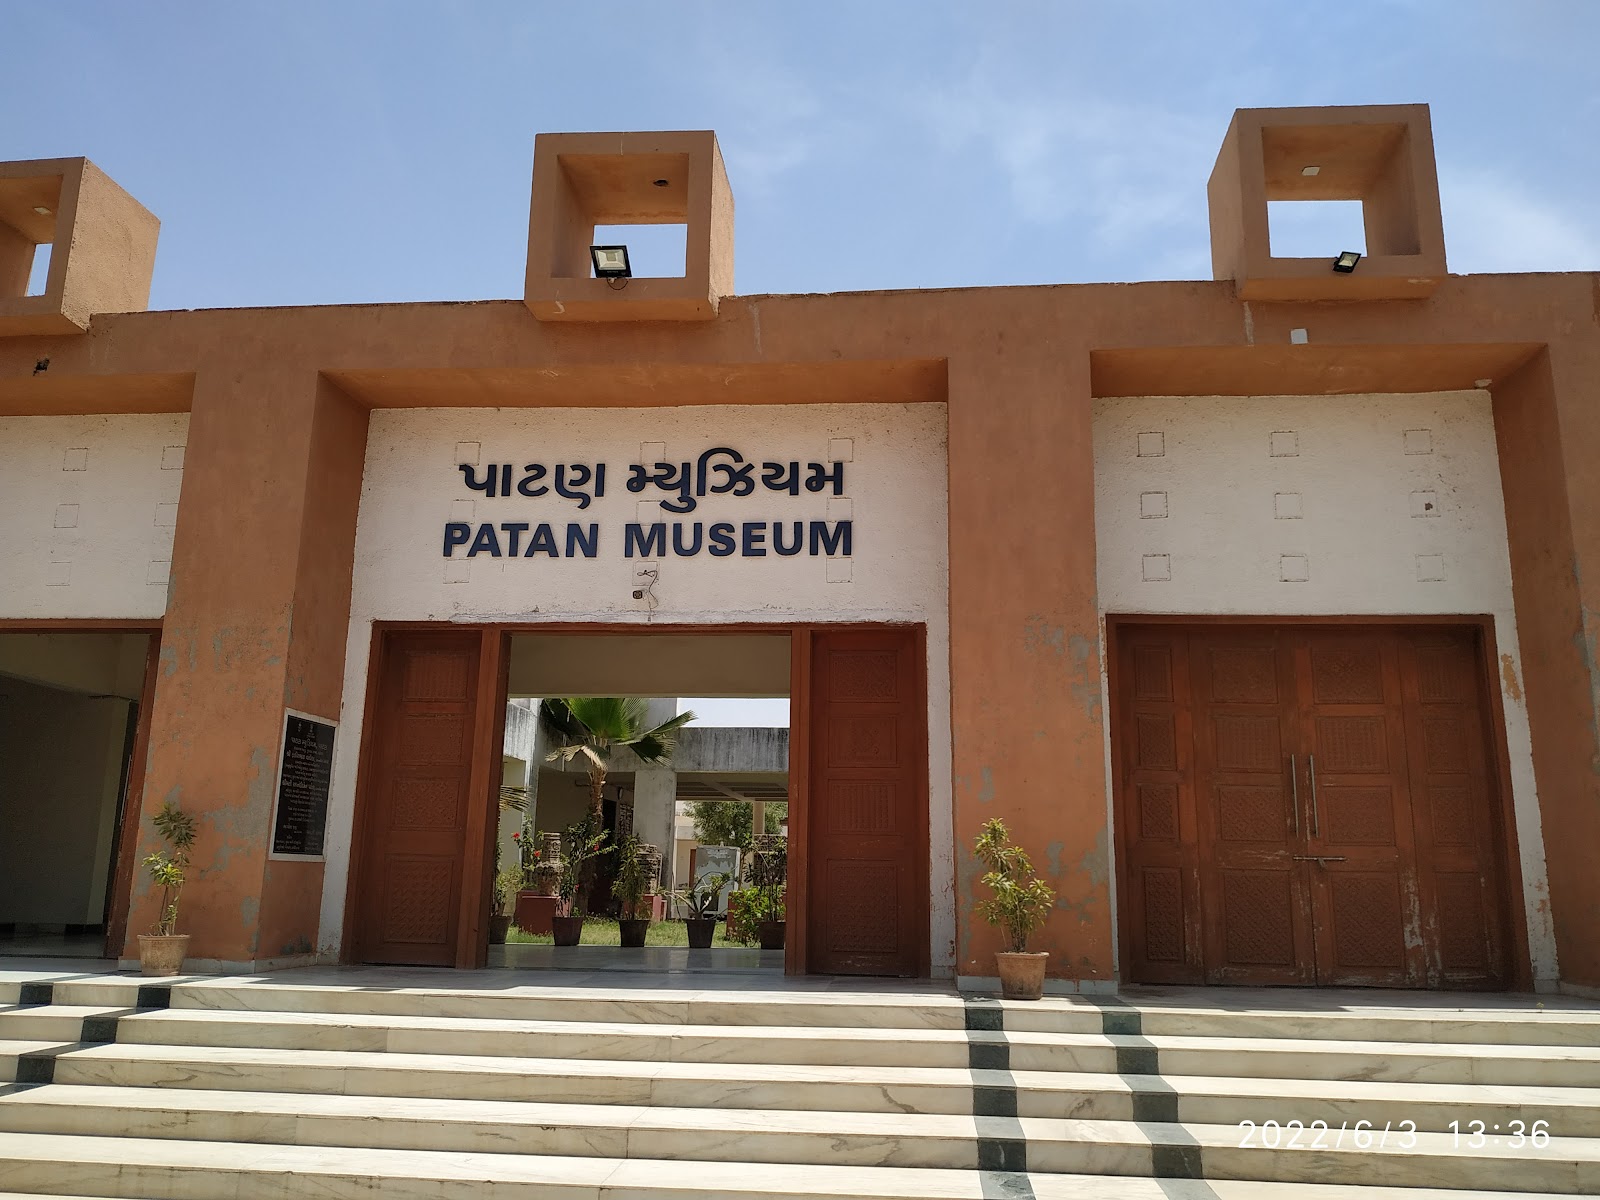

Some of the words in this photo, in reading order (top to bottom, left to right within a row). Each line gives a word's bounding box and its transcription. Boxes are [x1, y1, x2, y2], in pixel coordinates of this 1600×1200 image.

[458, 462, 606, 509] પાટણ
[626, 447, 843, 513] મ્યુઝિયમ
[442, 522, 599, 558] PATAN
[624, 520, 854, 558] MUSEUM
